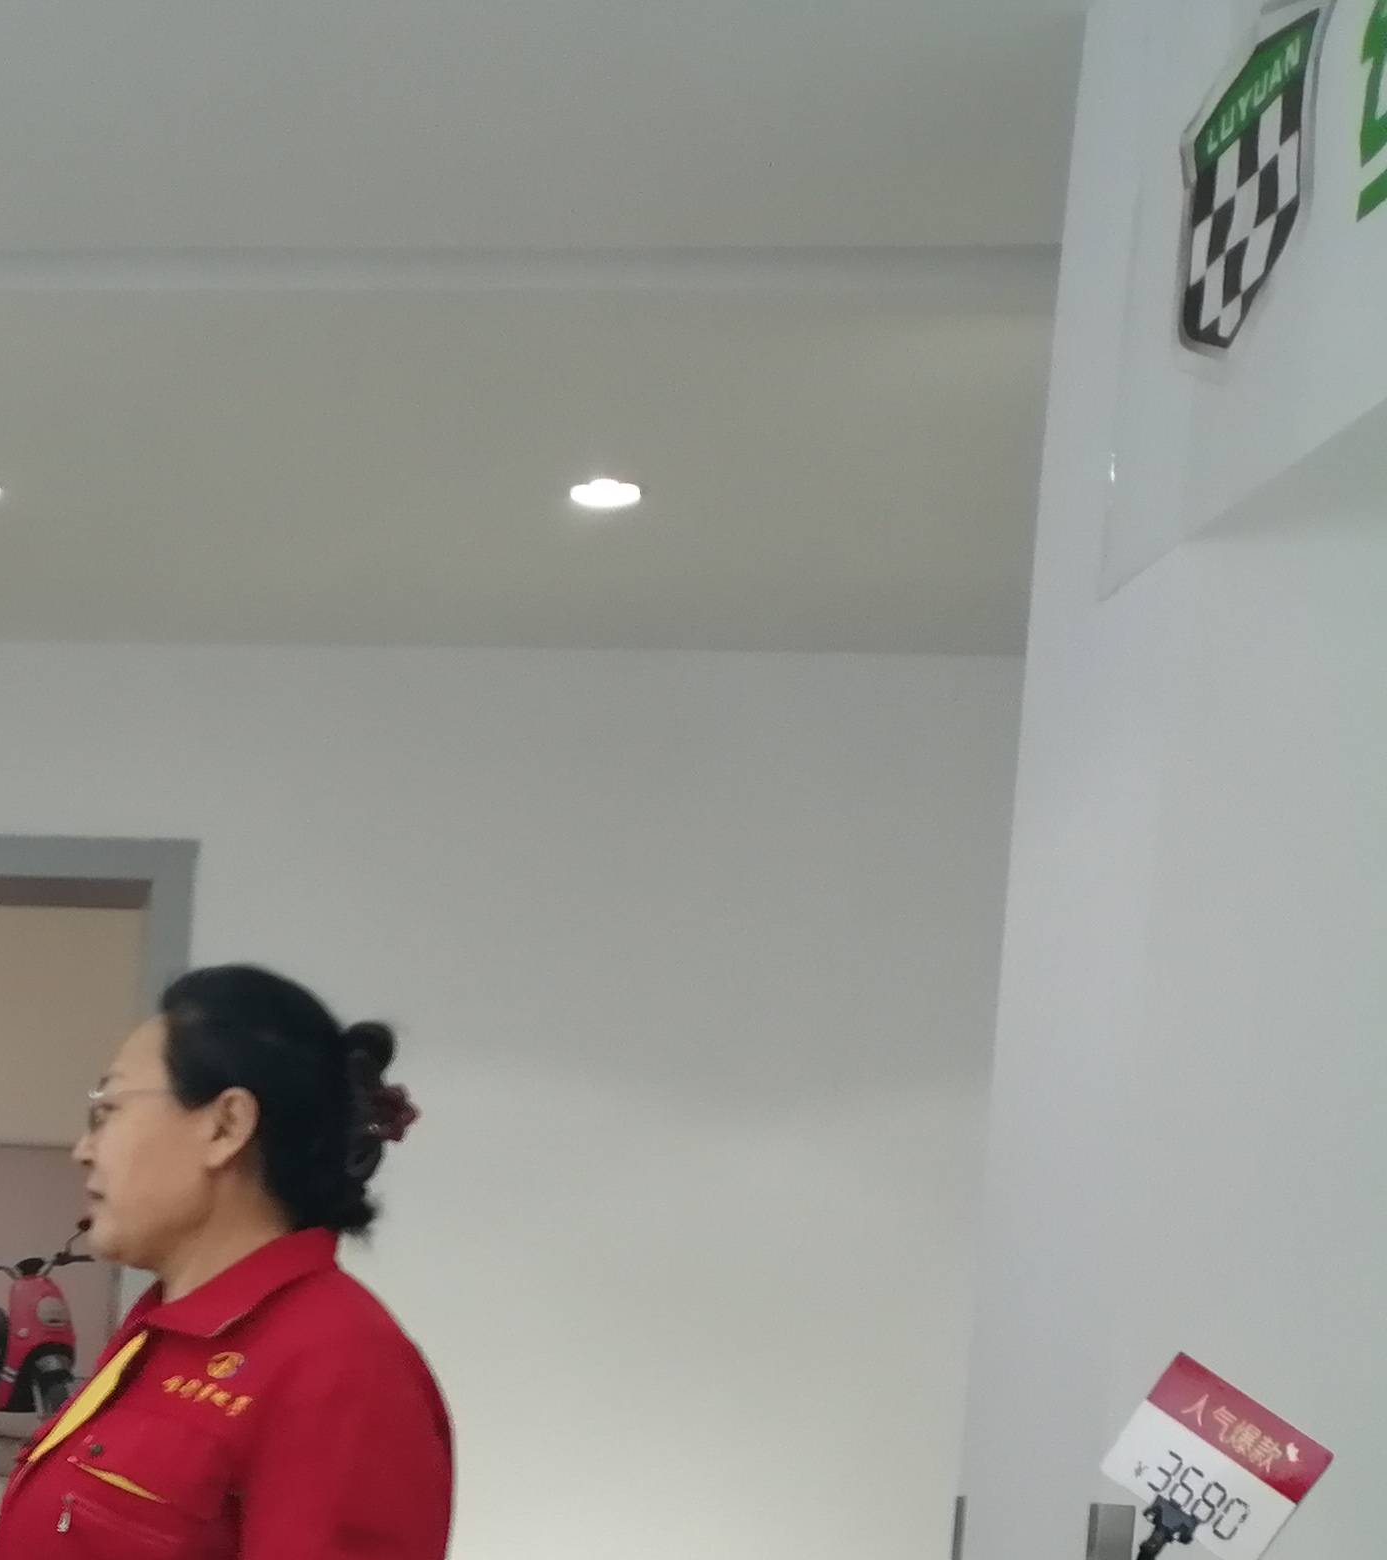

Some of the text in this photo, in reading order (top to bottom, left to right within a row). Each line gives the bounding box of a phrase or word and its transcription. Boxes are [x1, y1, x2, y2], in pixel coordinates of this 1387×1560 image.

[1206, 37, 1302, 156] LUYUAN
[1180, 1393, 1283, 1474] 人气爆款
[1147, 1449, 1251, 1541] 3680
